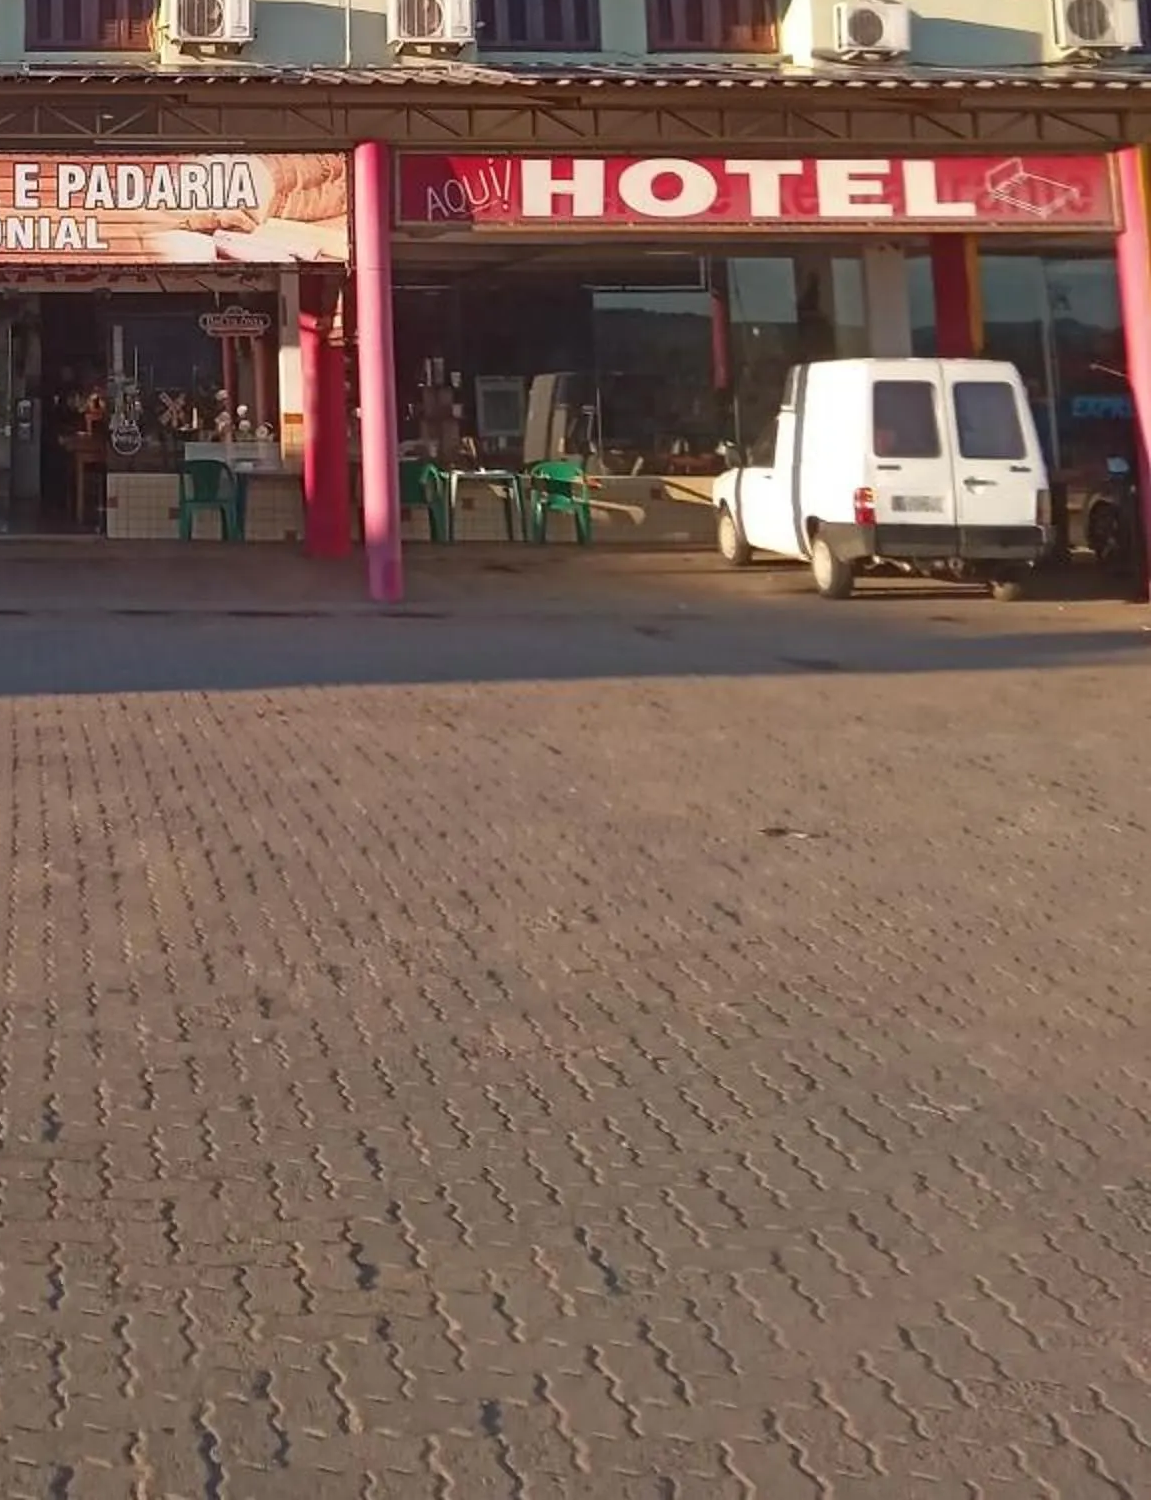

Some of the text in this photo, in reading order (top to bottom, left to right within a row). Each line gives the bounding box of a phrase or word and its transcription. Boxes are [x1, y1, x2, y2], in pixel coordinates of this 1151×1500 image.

[13, 162, 41, 209] E
[56, 162, 259, 209] PADARIA
[520, 157, 977, 217] HOTEL
